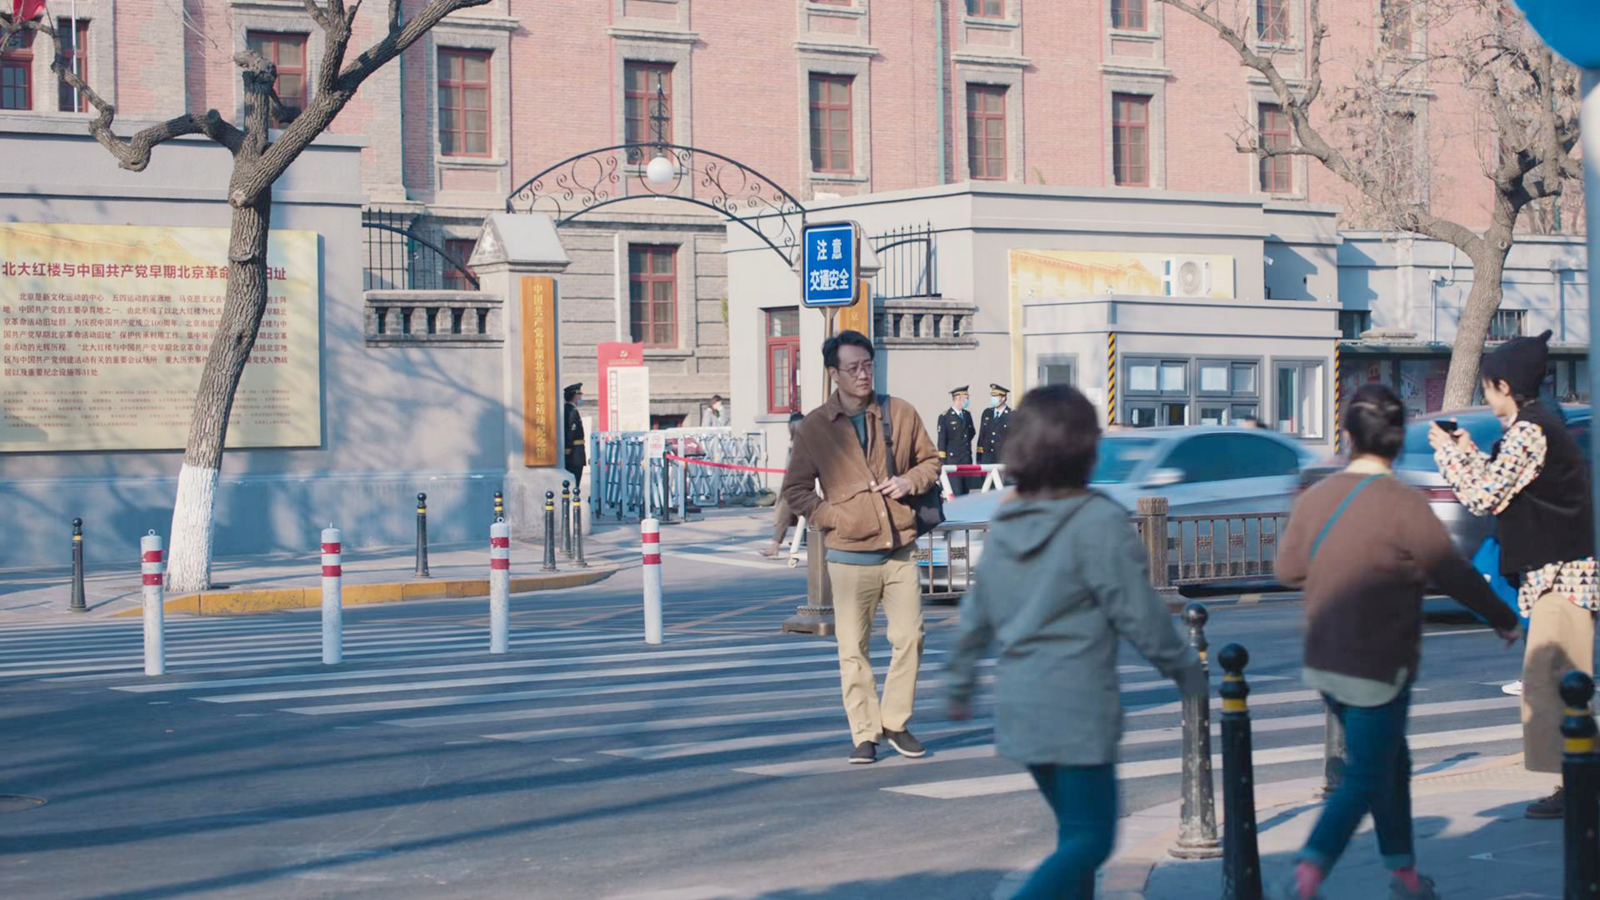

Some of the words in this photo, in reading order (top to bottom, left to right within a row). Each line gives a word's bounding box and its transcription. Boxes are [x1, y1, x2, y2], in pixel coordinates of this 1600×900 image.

[817, 238, 842, 261] 注意
[810, 268, 849, 291] 交通安全
